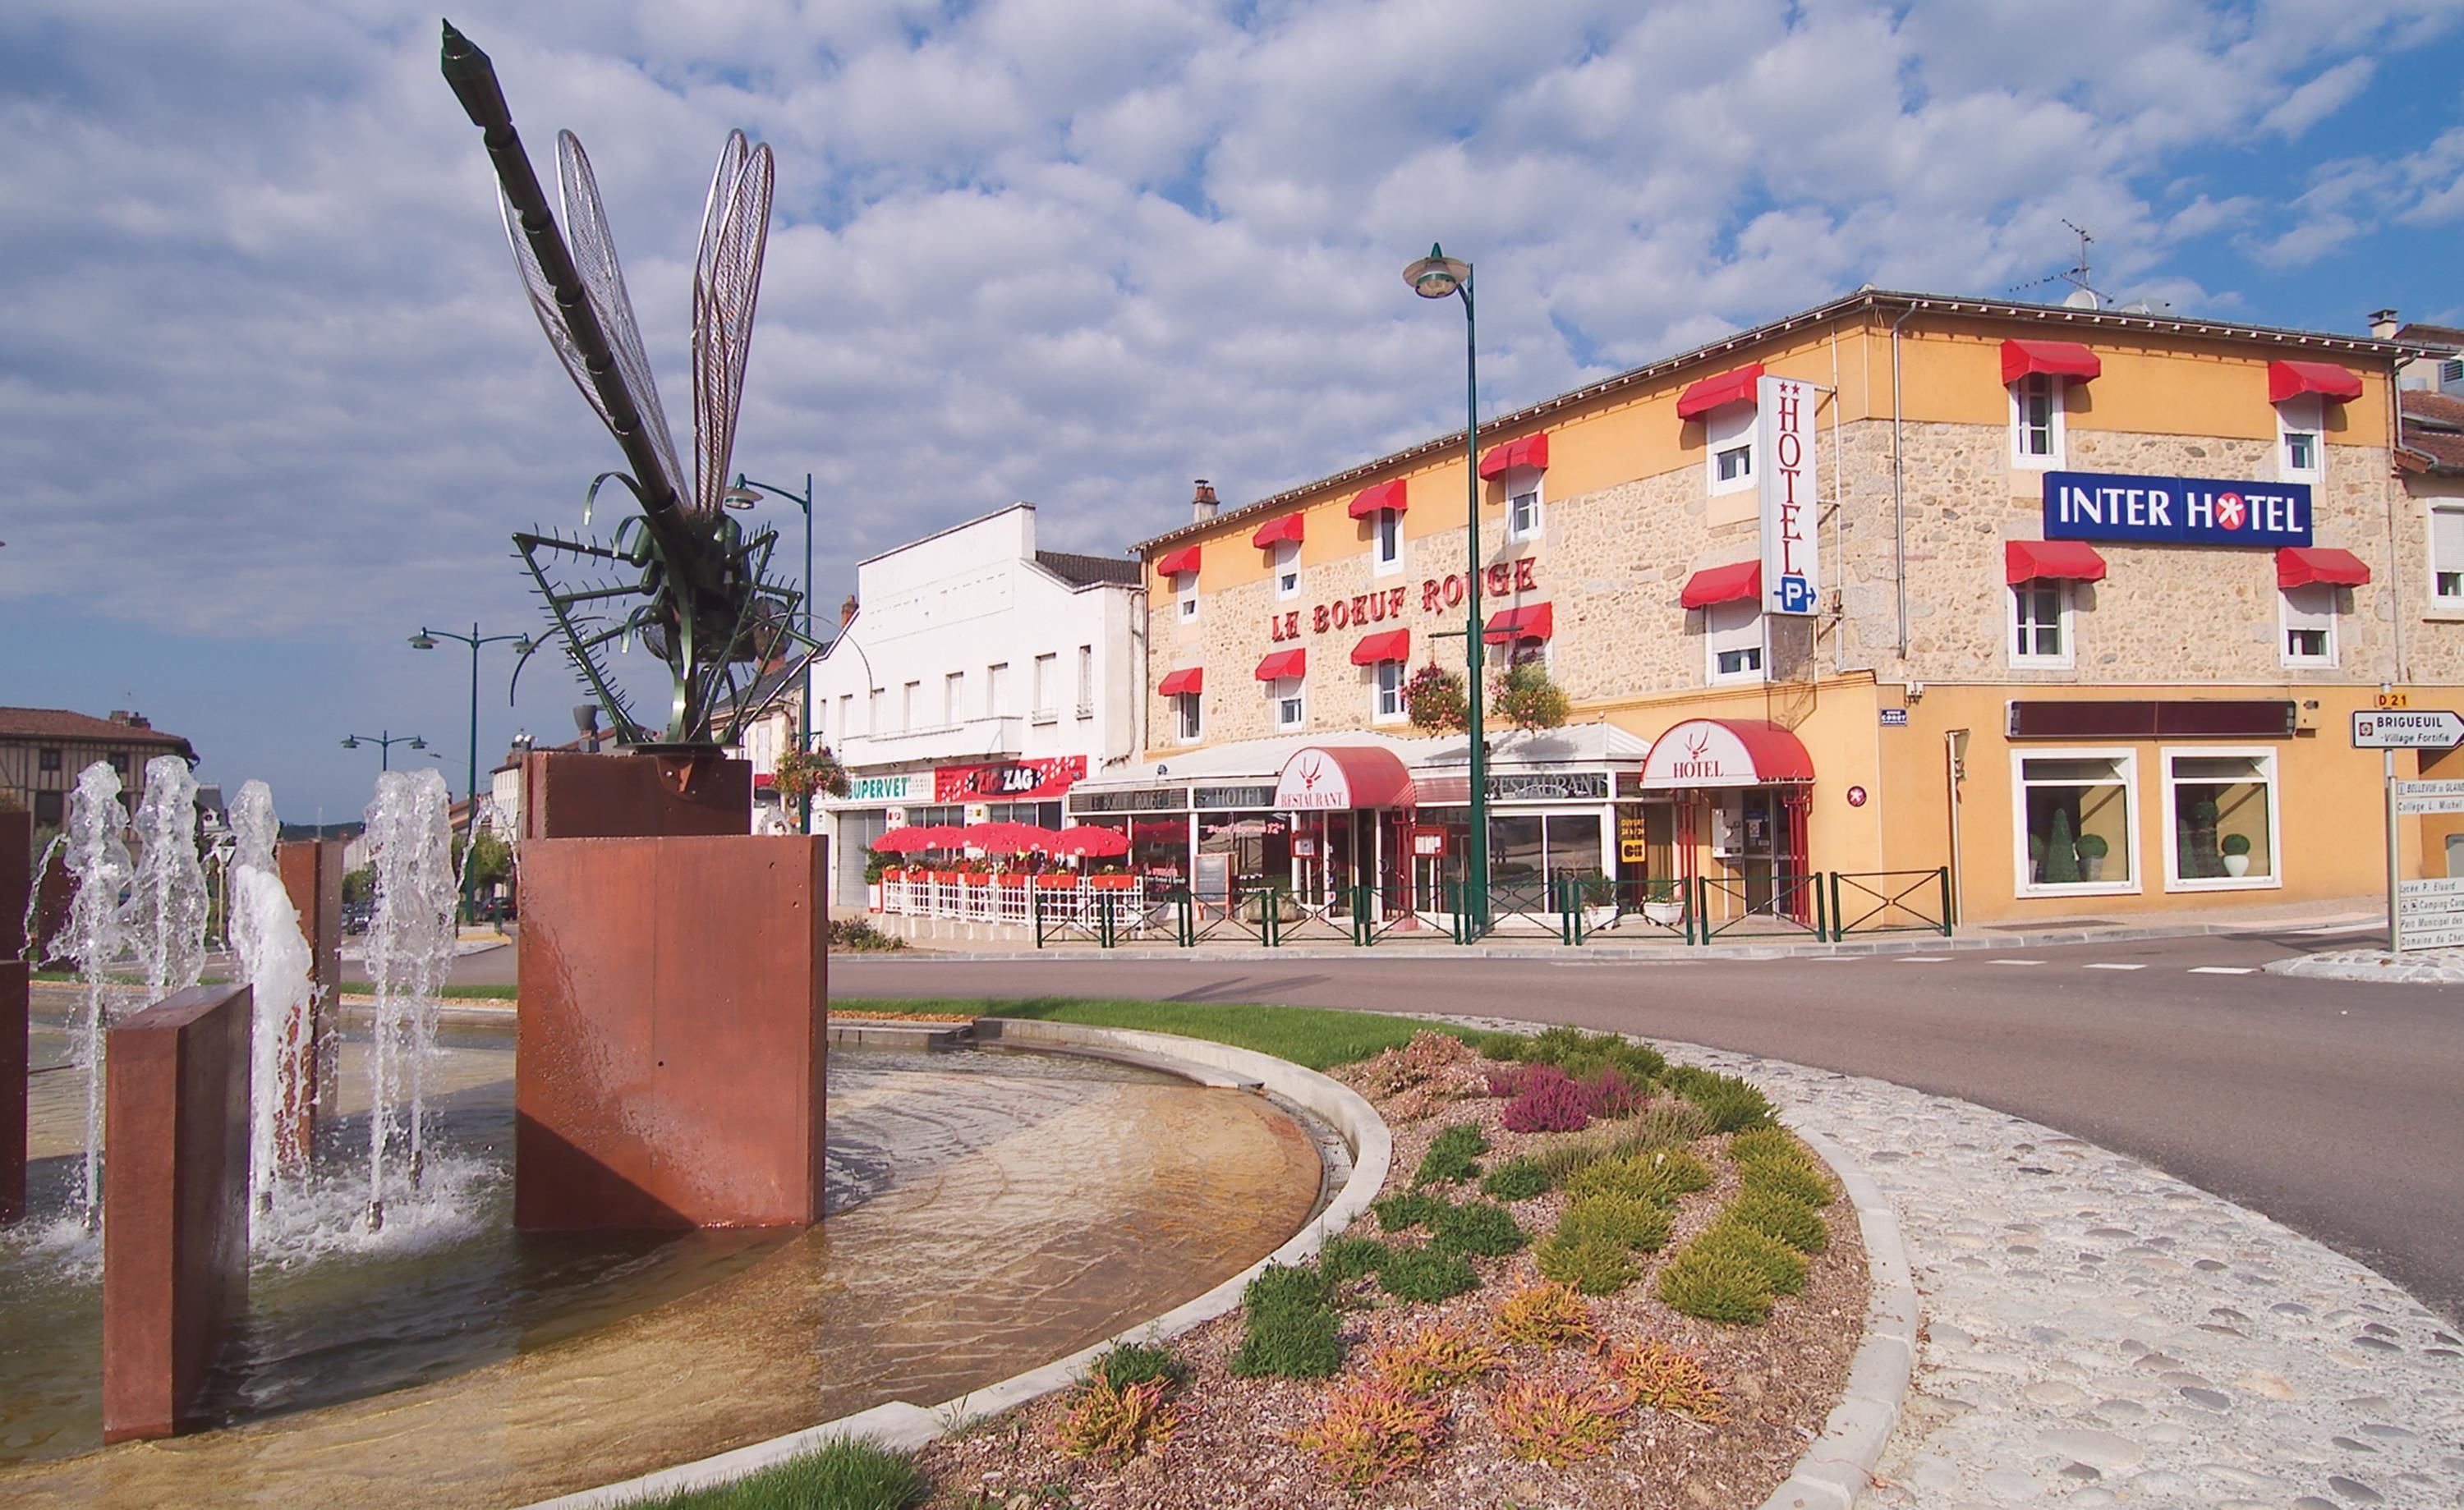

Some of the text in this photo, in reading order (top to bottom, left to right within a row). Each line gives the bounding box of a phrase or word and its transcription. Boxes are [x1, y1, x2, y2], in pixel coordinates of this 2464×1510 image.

[1778, 397, 1804, 576] HOTEL
[2059, 486, 2172, 526] INTER
[1271, 610, 1301, 642] LE
[1313, 585, 1407, 634] BOEUF
[2379, 694, 2407, 706] D 21
[2376, 716, 2443, 727] BRIGUEUIL
[1003, 768, 1034, 792] ZAG
[1673, 760, 1724, 778] HOTEL
[1487, 773, 1607, 798] RESTAURANT
[1215, 787, 1266, 807] HOTEL
[1280, 792, 1345, 808] RESTAURANT
